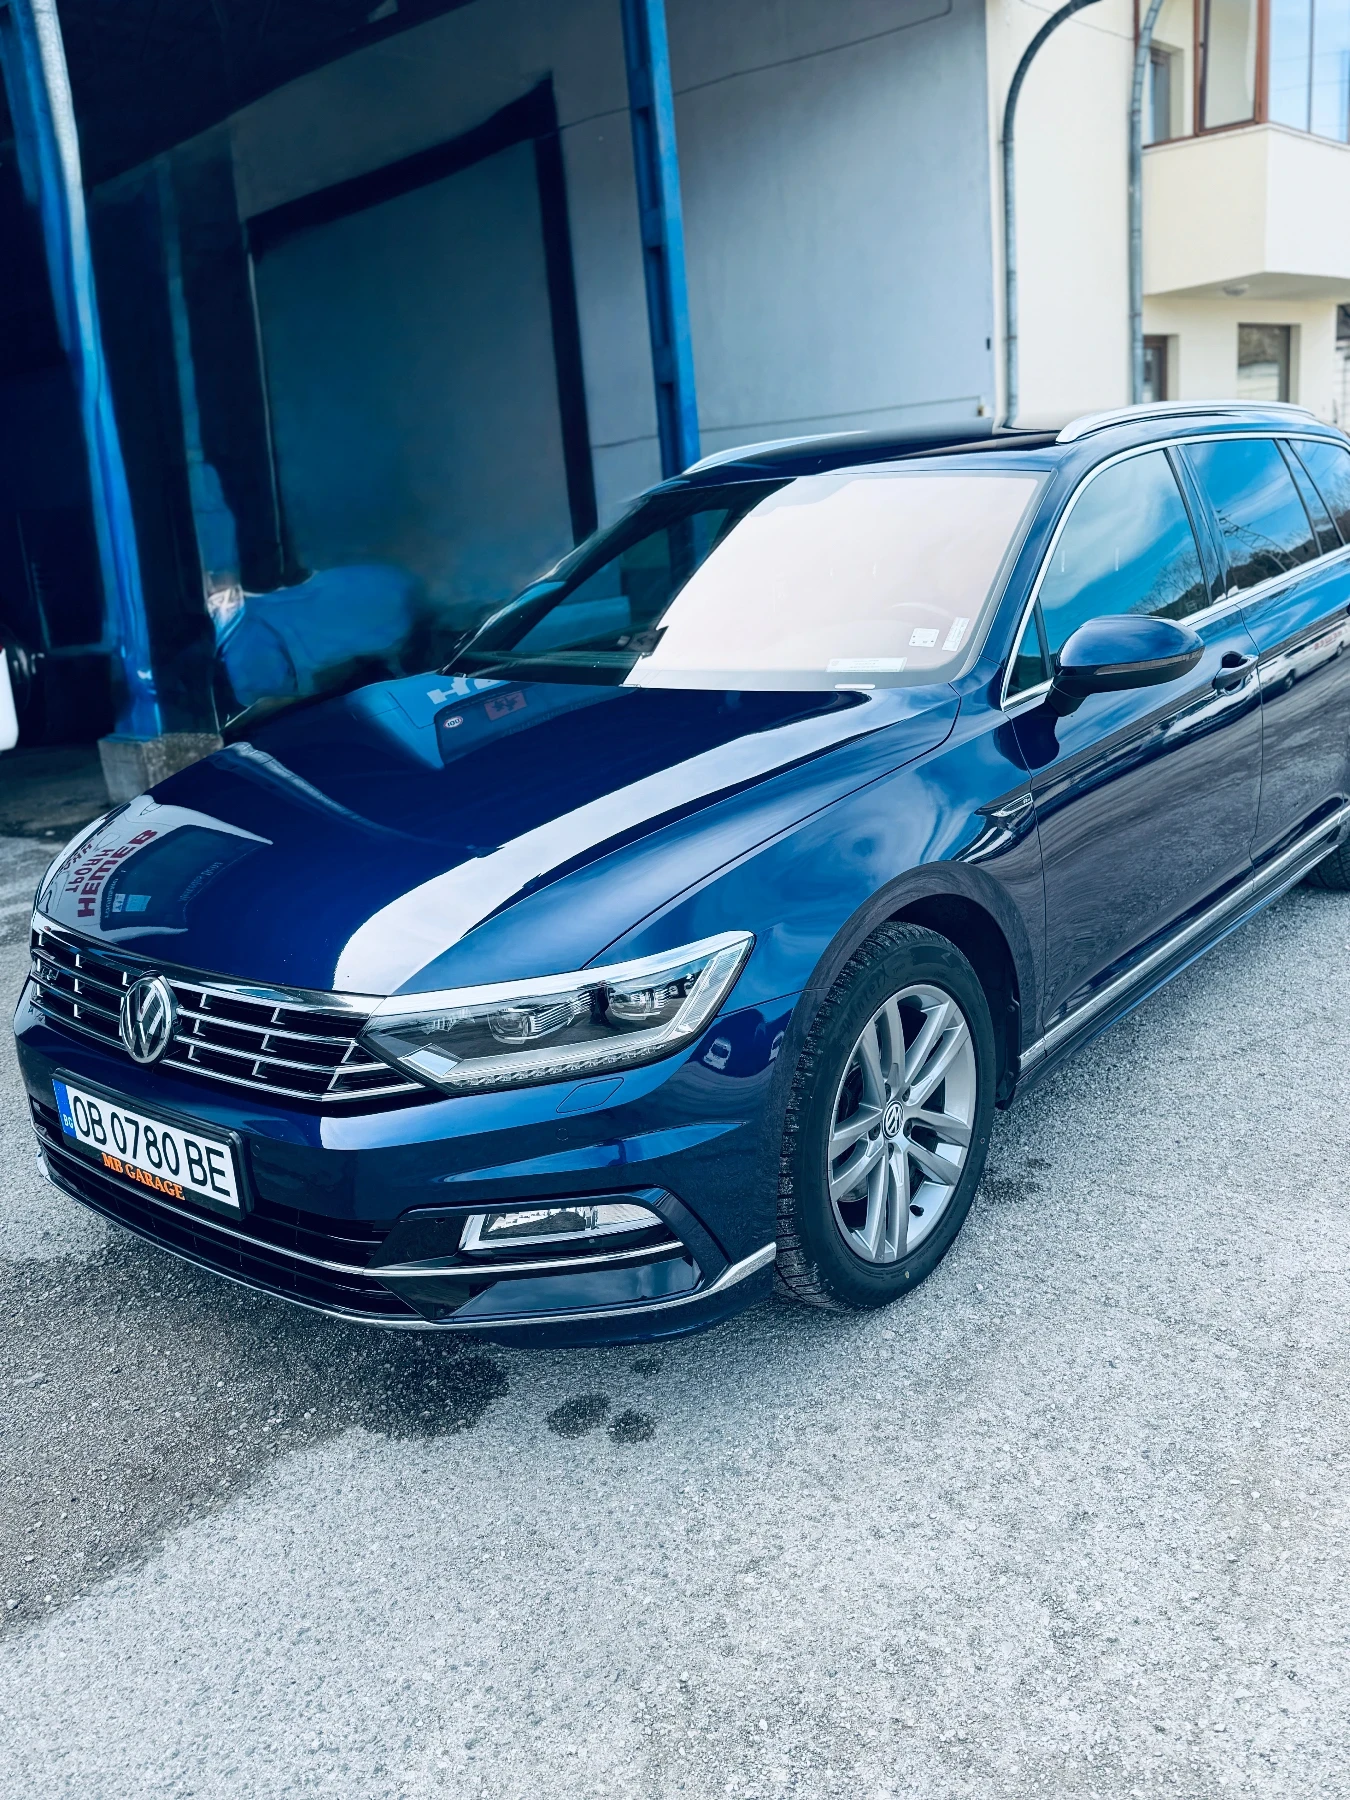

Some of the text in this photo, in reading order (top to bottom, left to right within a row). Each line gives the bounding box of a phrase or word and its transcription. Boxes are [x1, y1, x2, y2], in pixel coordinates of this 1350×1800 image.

[62, 1113, 74, 1130] BG
[73, 1095, 231, 1198] OB 0780 BE
[101, 1152, 186, 1201] MB GARAGE
